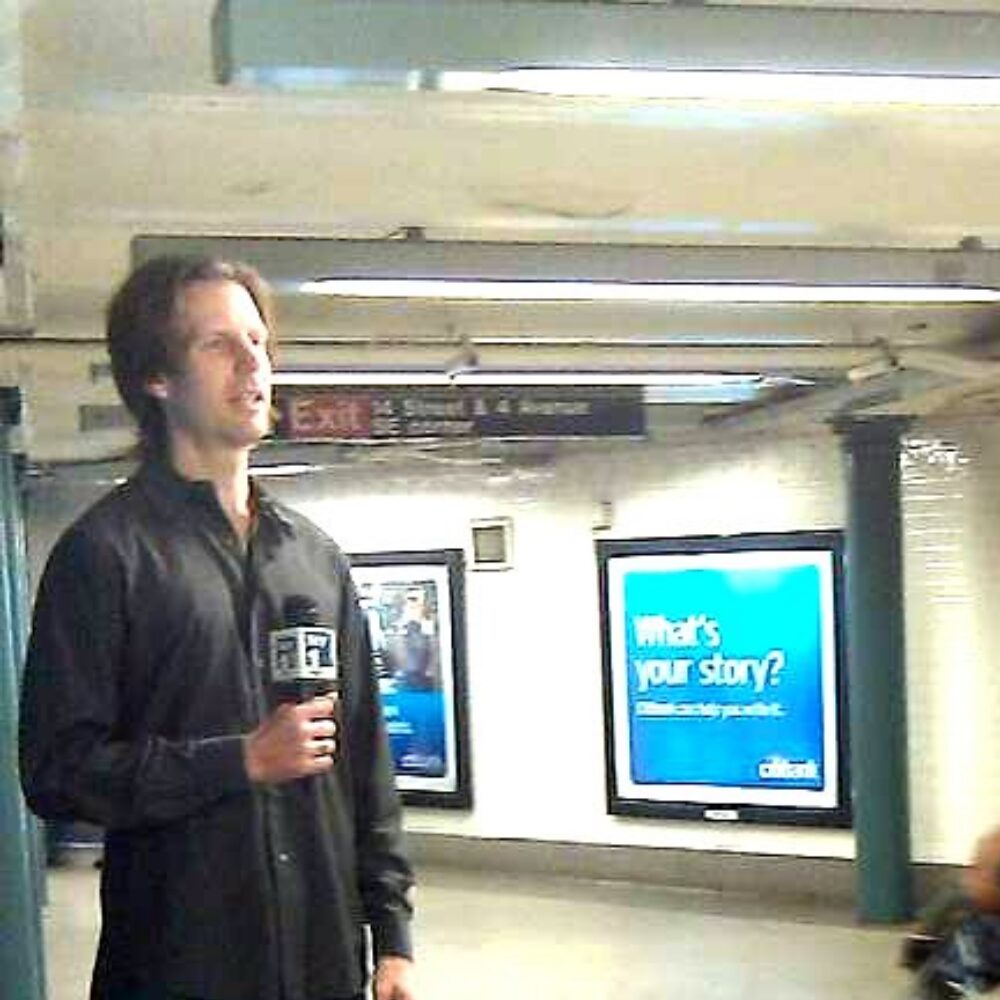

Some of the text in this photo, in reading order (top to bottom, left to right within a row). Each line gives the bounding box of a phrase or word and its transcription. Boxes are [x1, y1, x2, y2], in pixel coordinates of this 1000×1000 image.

[289, 399, 363, 432] Exit
[633, 614, 721, 648] What's
[633, 650, 786, 693] your story?
